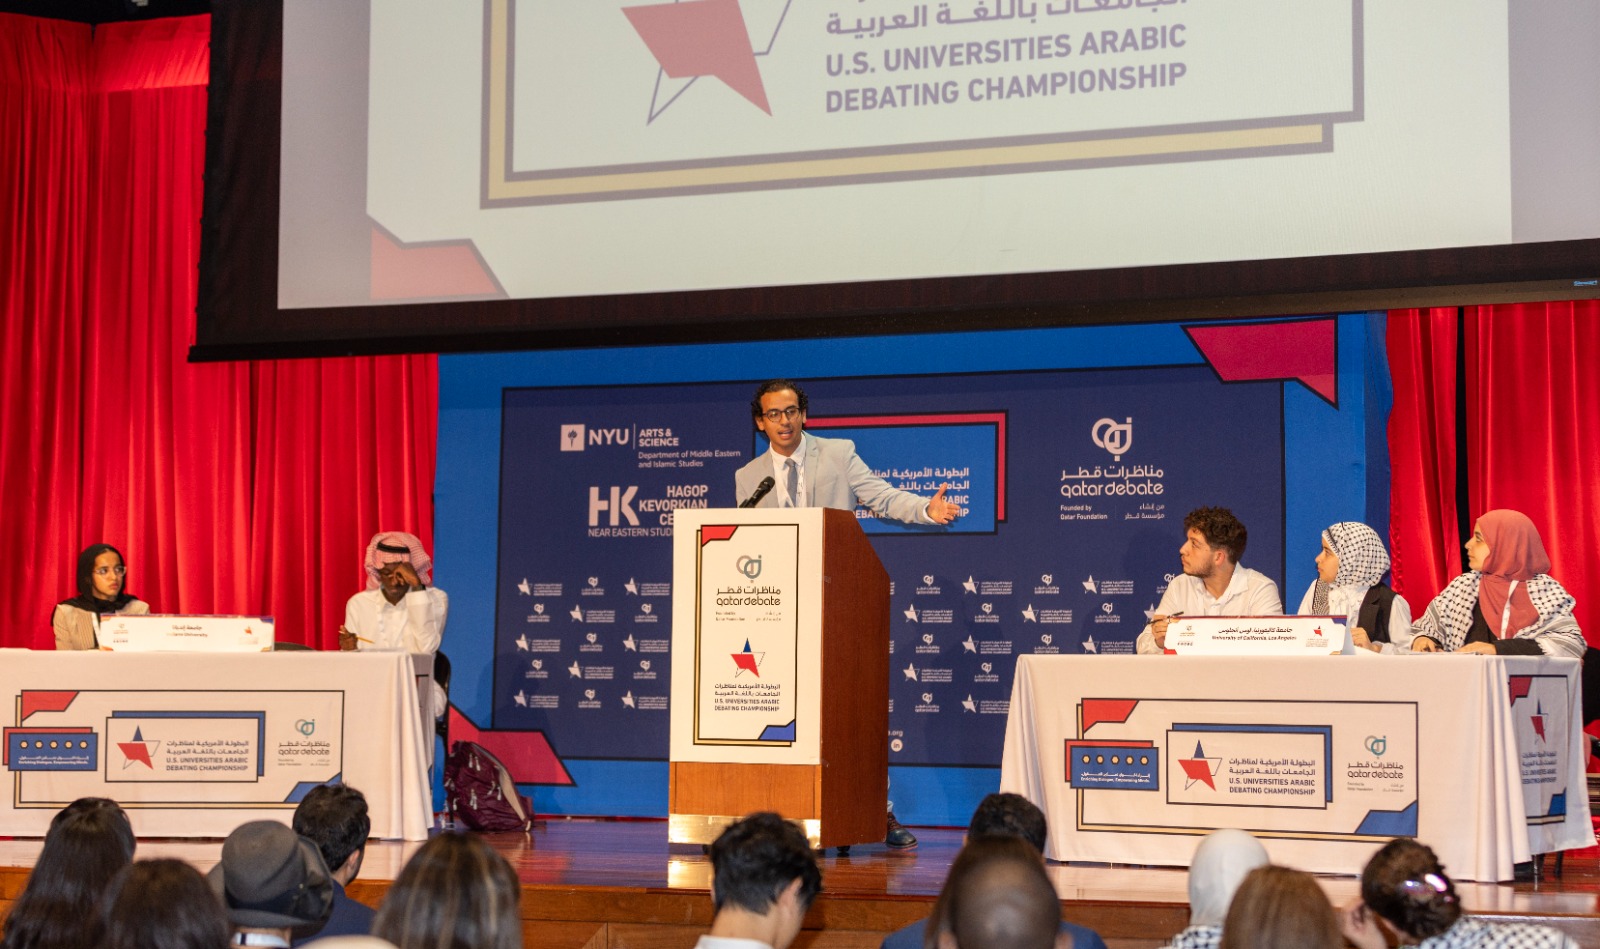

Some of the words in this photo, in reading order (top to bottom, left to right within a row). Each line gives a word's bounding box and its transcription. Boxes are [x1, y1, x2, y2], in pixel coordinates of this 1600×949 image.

[826, 5, 927, 39] العربية
[826, 51, 876, 77] U.S.
[884, 34, 1072, 72] UNIVERSITIES
[1079, 23, 1187, 56] ARABIC
[826, 81, 960, 113] DEBATING
[968, 62, 1187, 102] CHAMPIONSHIP
[589, 428, 629, 446] NYU
[639, 428, 664, 438] ARTS
[665, 428, 672, 437] &
[639, 438, 679, 447] SCIENCE
[638, 451, 679, 460] Department
[681, 450, 689, 458] of
[690, 450, 713, 458] Middle
[714, 449, 741, 457] Eastern
[653, 460, 676, 468] Islamic
[678, 459, 704, 468] Studies
[935, 467, 969, 479] البطولة
[1061, 465, 1102, 481] قطر
[1104, 464, 1164, 480] مناظرات
[667, 485, 708, 498] HAGOP
[588, 486, 640, 526] HK
[639, 499, 708, 512] KEVORKIAN
[1085, 504, 1092, 512] by
[588, 528, 611, 537] NEAR
[612, 528, 648, 537] EASTERN
[717, 586, 742, 595] قطر
[743, 586, 781, 595] مناظرات
[1229, 777, 1241, 785] U.S.
[1243, 778, 1289, 786] UNIVERSITIES
[1290, 779, 1315, 787] ARABIC
[1229, 786, 1262, 794] DEBATING
[1263, 788, 1316, 796] CHAMPIONSHIP
